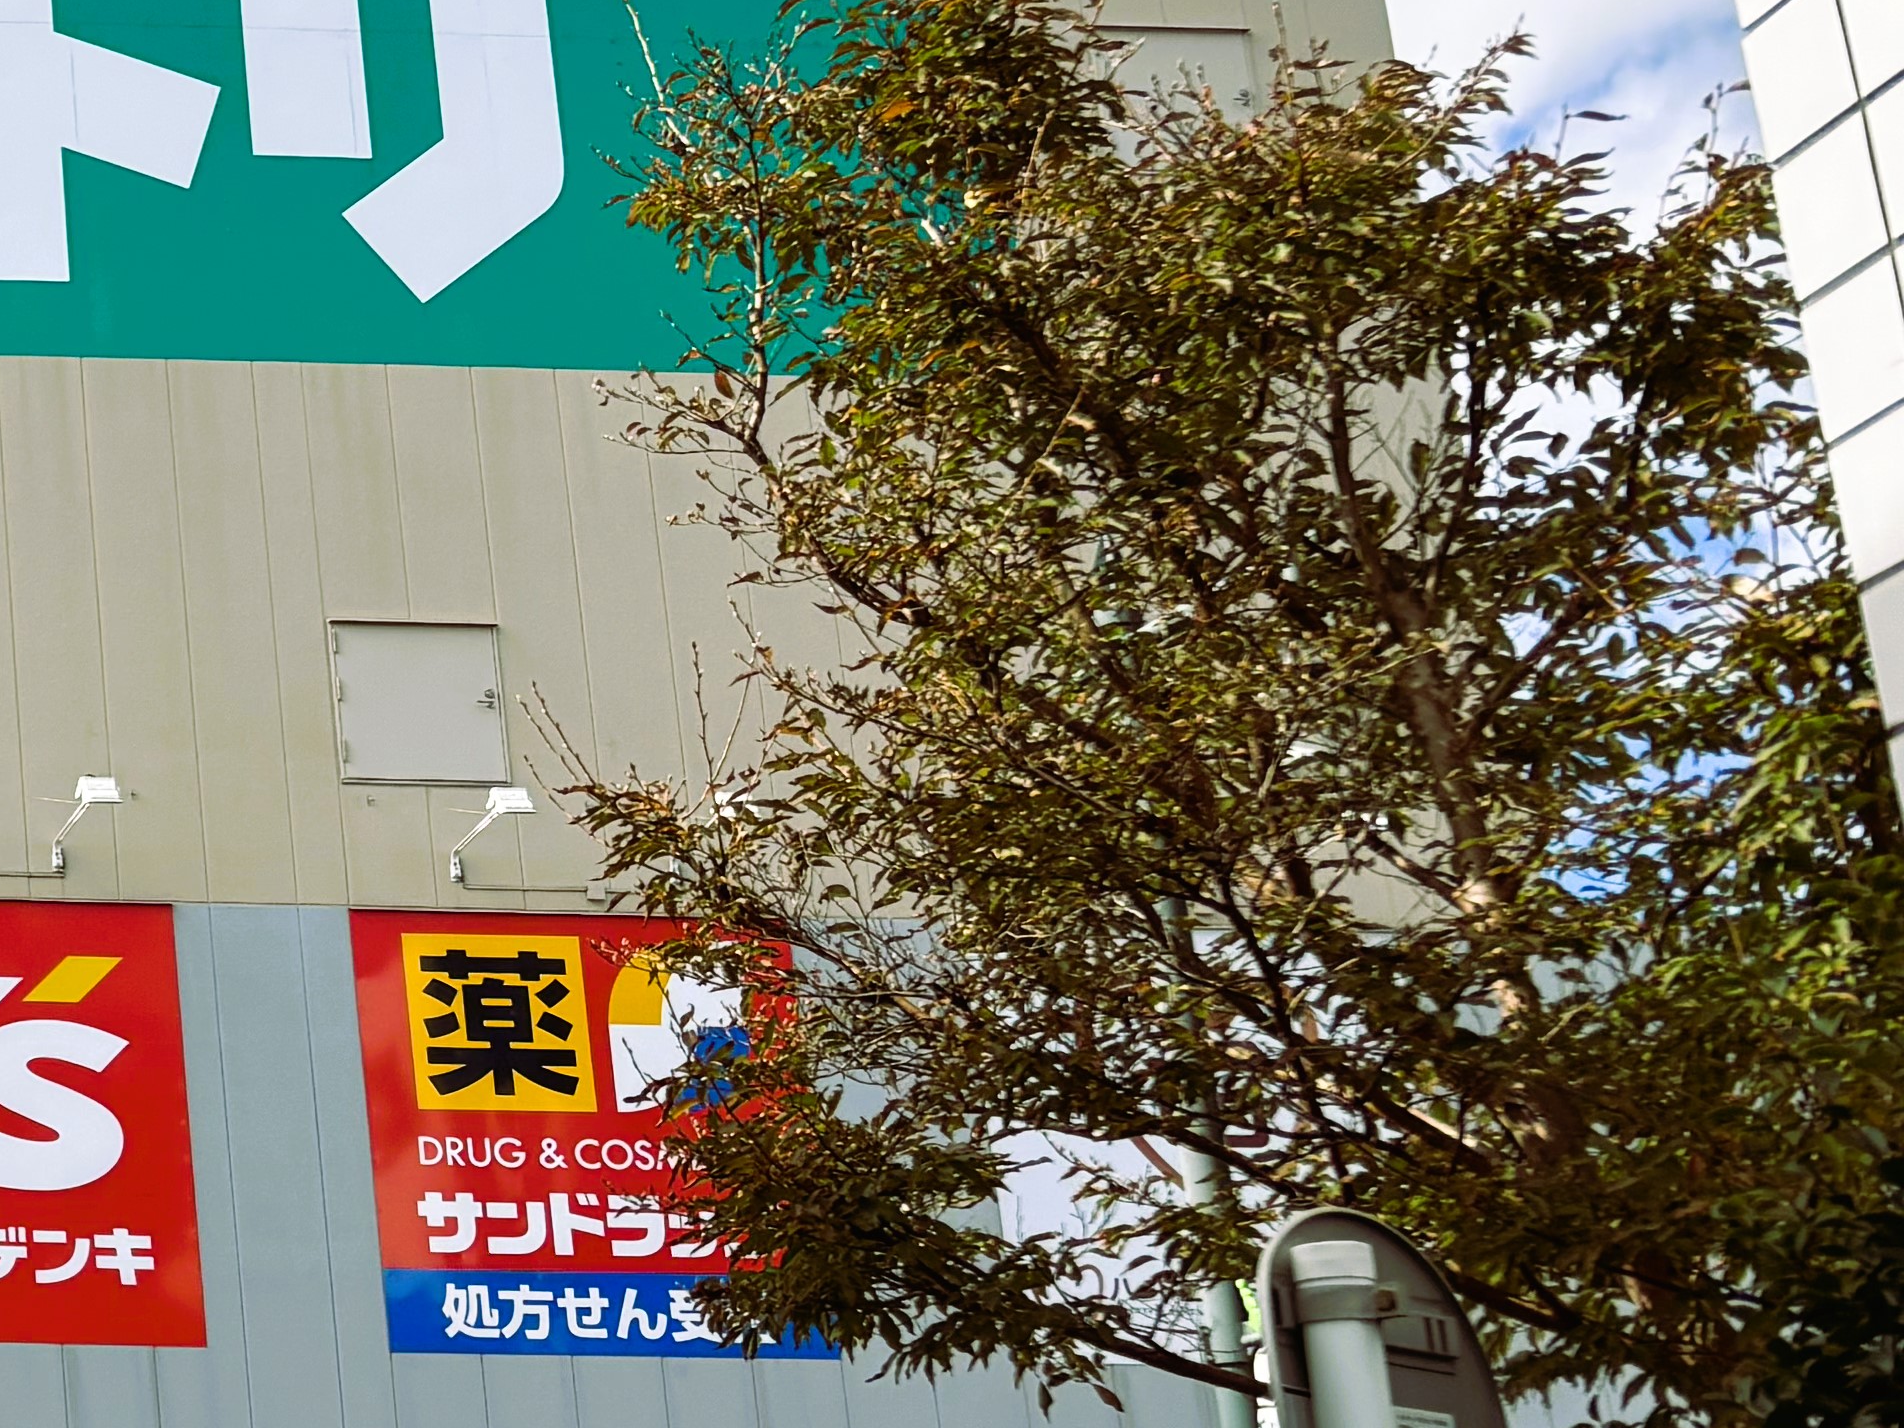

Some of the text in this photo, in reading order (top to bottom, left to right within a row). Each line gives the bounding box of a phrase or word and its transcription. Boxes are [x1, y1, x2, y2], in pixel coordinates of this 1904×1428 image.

[419, 949, 579, 1096] 薬
[417, 1136, 527, 1169] DRUG
[540, 1140, 569, 1170] &
[442, 1283, 779, 1345] 処方せん受
